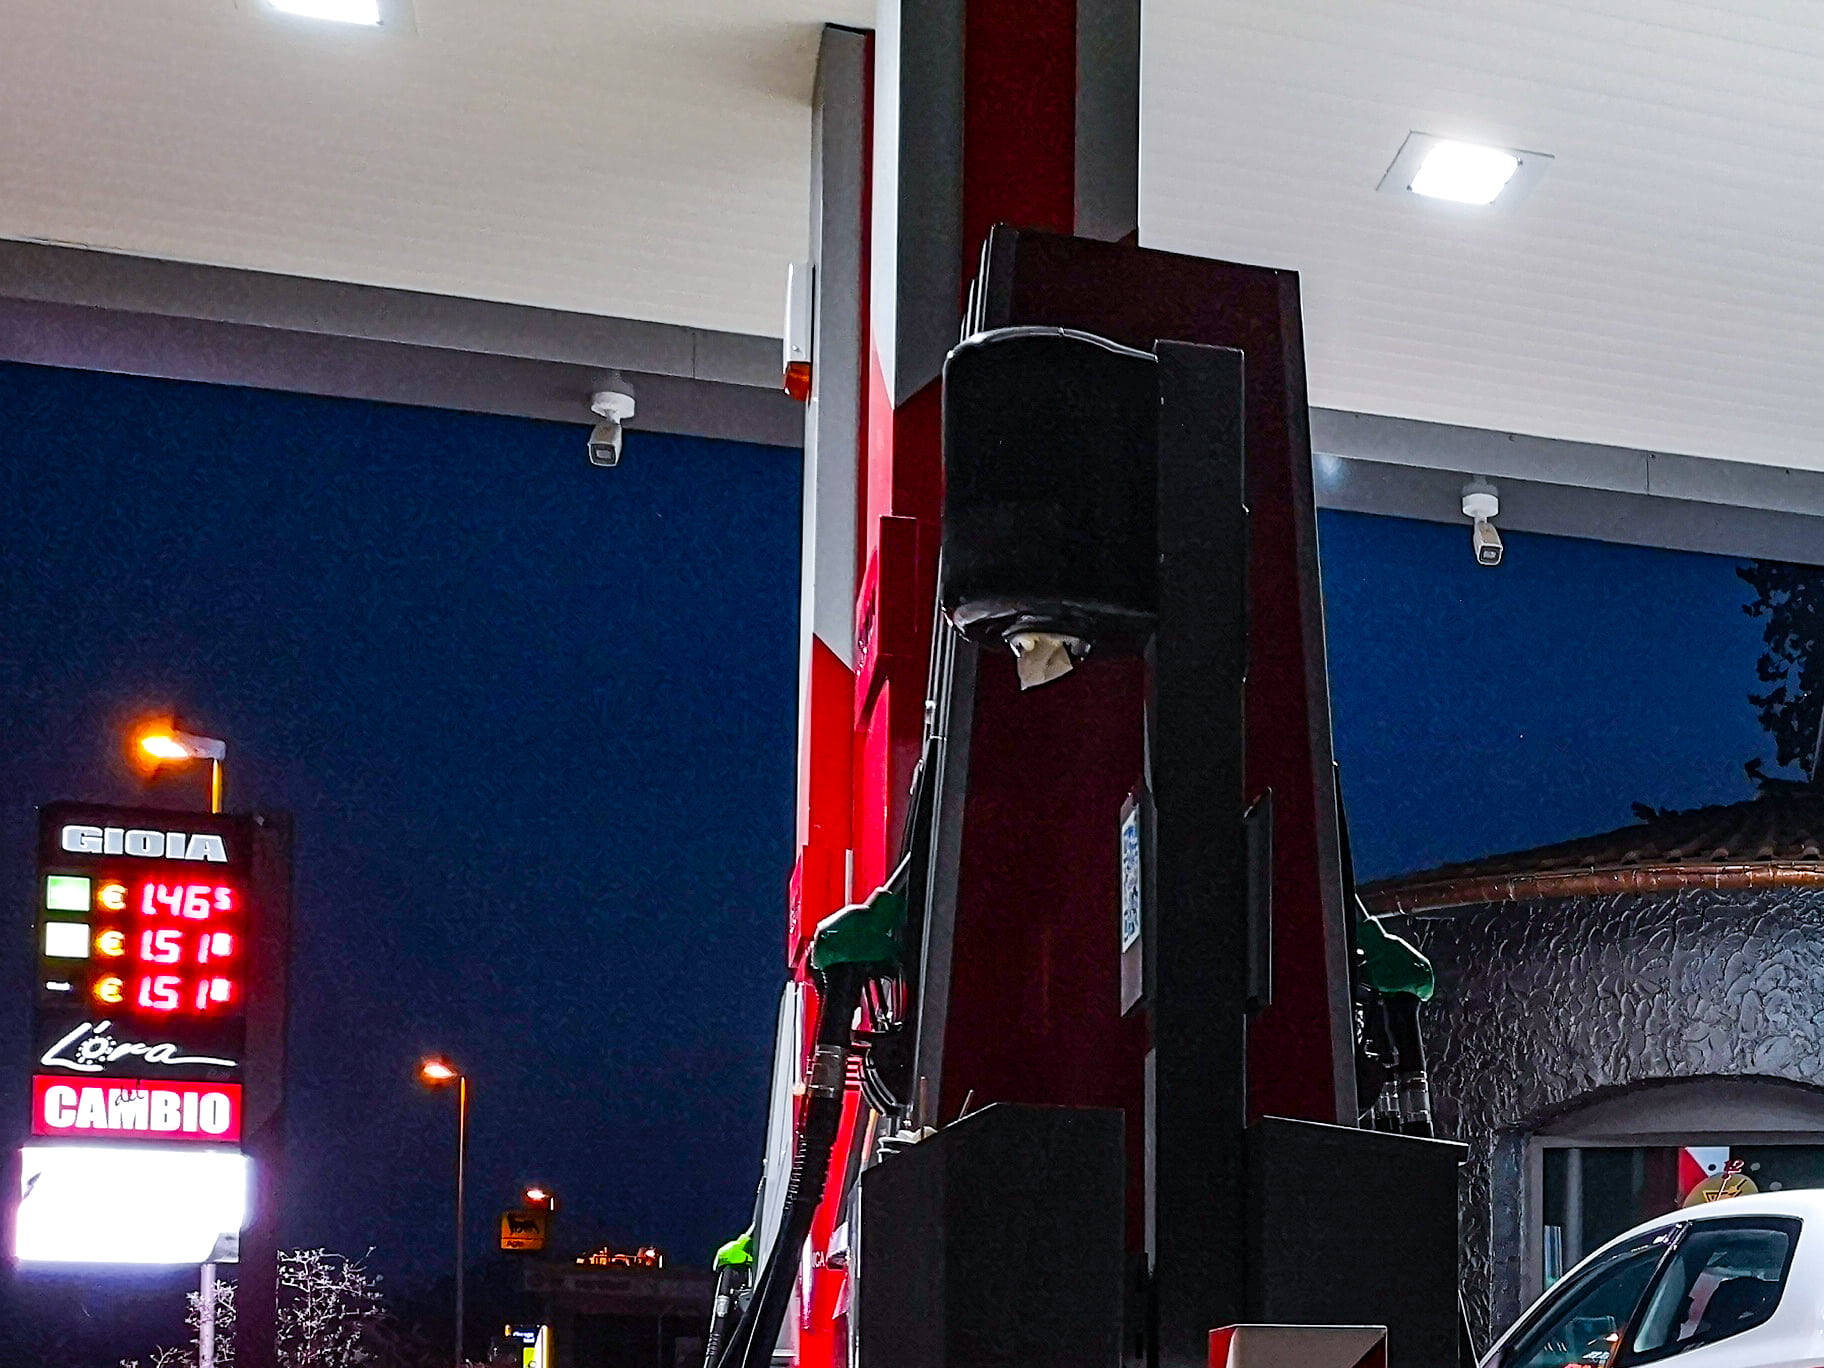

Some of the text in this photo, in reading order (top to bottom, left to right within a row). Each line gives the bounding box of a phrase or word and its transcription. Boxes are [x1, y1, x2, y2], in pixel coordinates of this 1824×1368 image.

[61, 825, 228, 863] GIOIA
[98, 884, 128, 910] €
[95, 930, 125, 957] €
[93, 977, 123, 1003] €
[40, 1020, 239, 1072] L'ora
[43, 1084, 231, 1135] CAMBIO
